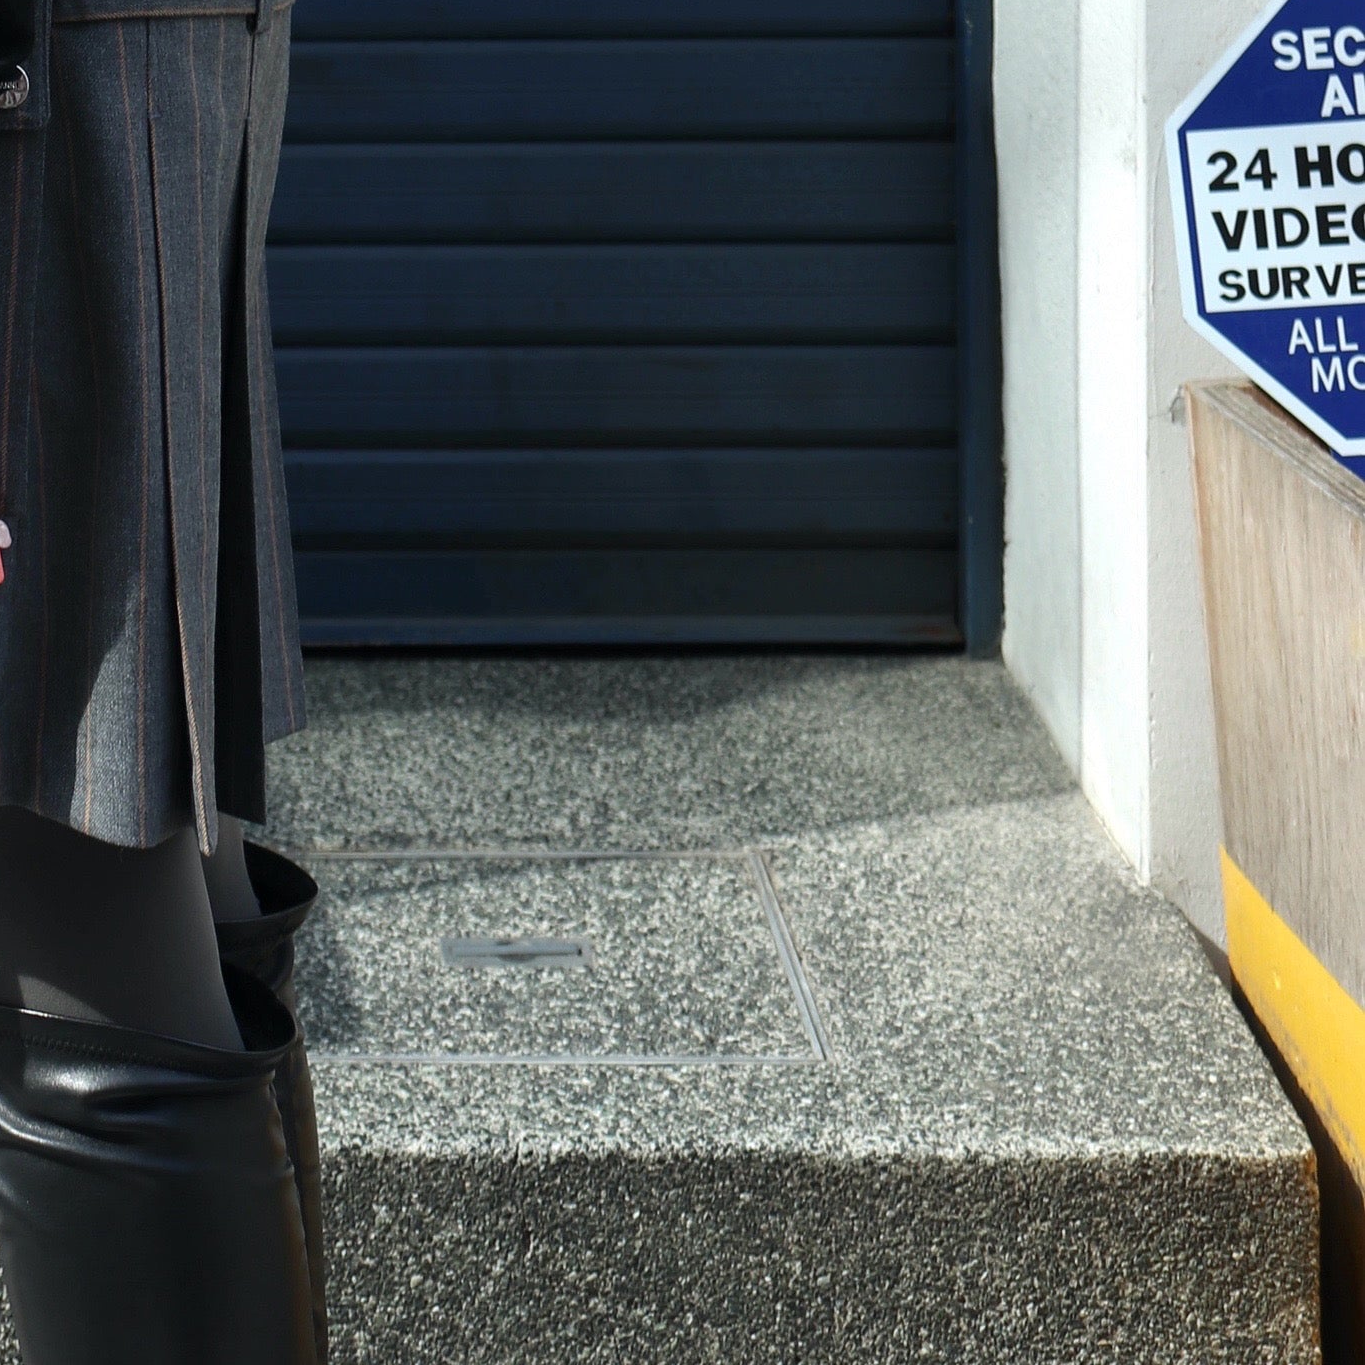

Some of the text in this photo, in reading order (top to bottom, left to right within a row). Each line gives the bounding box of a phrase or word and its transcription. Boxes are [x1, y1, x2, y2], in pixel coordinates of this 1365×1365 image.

[1272, 26, 1365, 71] SEC
[1207, 143, 1365, 192] 24 HO
[1218, 263, 1365, 302] SURVE
[1289, 316, 1358, 355] ALL
